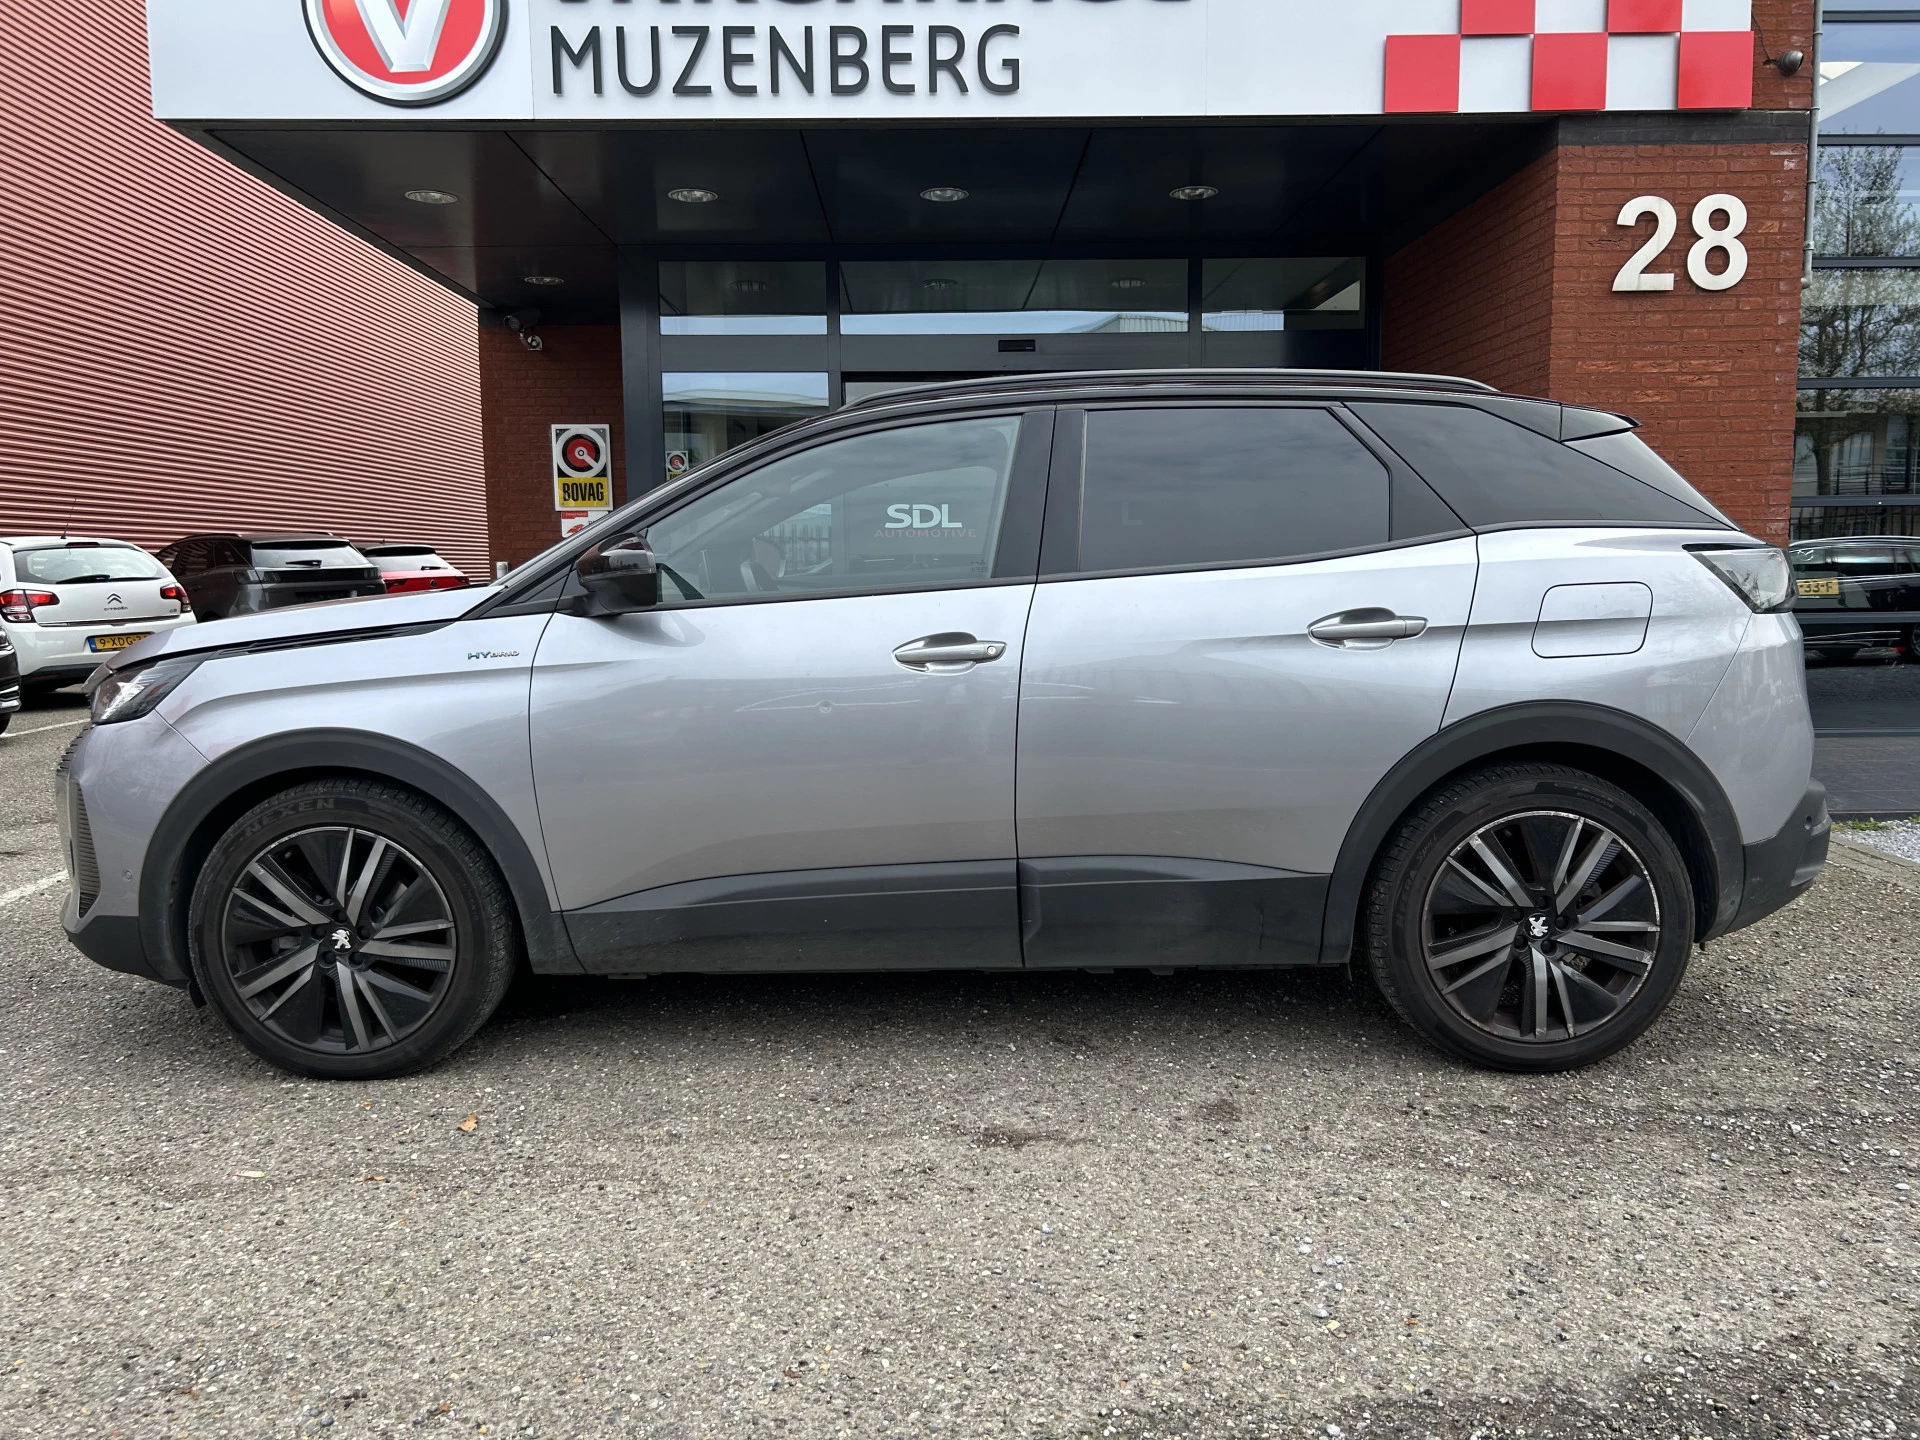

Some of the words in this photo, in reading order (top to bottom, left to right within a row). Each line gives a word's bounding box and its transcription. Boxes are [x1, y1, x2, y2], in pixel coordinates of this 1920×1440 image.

[550, 23, 1021, 96] MUZENBERG
[1611, 193, 1748, 292] 28
[562, 482, 604, 502] BOVAG
[884, 503, 963, 529] SDL
[873, 529, 977, 539] AUTOMOTIVE
